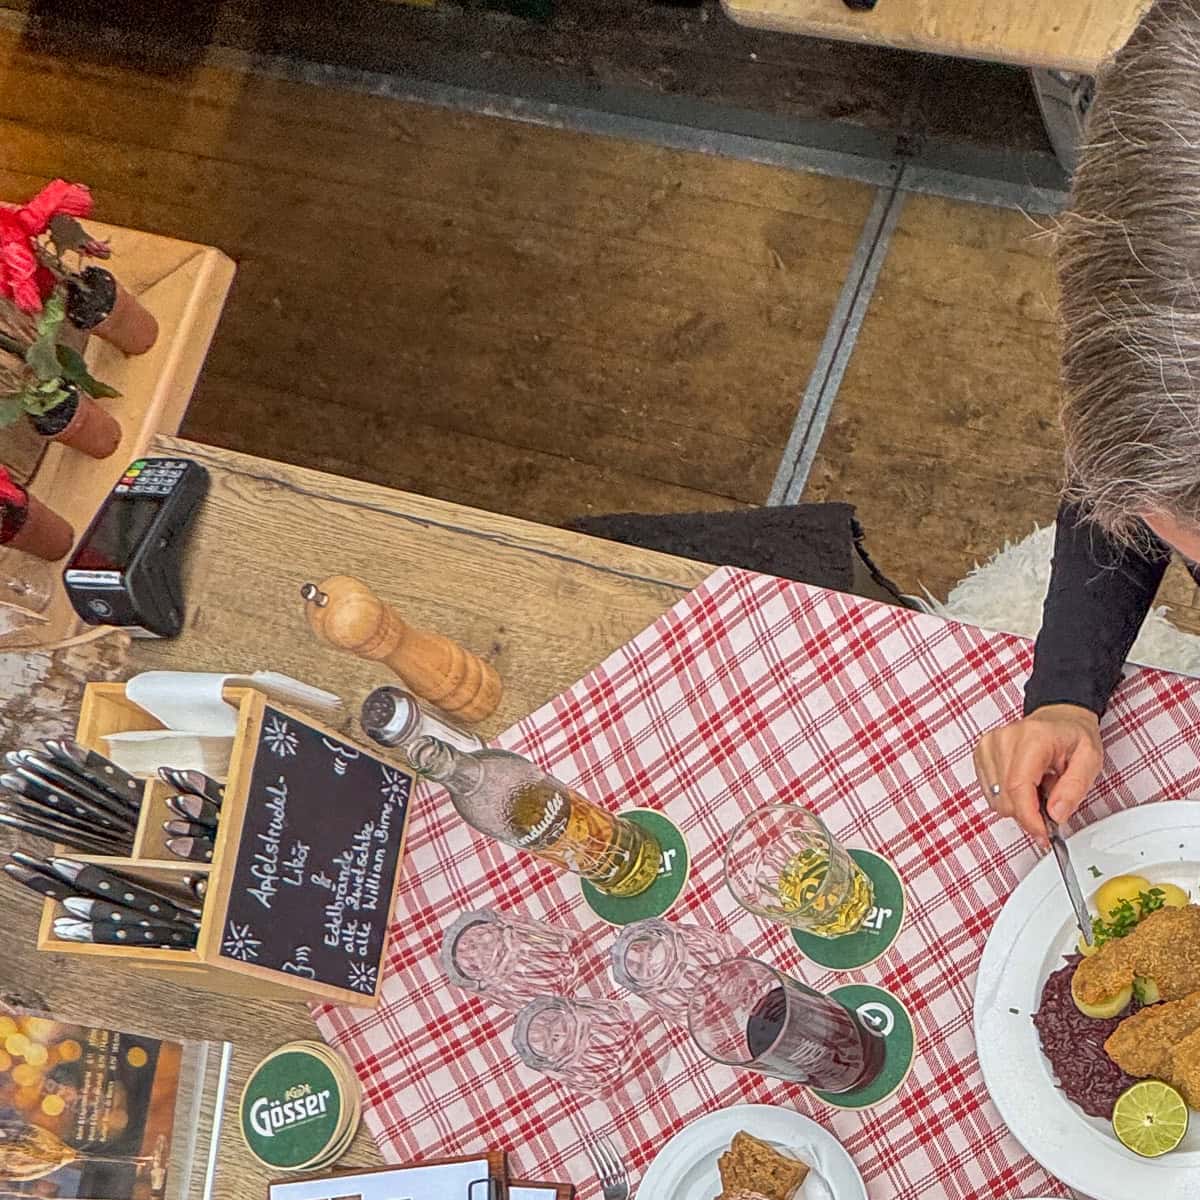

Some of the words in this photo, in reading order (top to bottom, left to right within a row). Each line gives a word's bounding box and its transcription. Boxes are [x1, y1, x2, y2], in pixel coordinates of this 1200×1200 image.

[246, 775, 288, 909] Apfelstrudel-
[375, 801, 395, 843] Birne
[283, 839, 311, 887] Likör
[310, 871, 332, 888] &
[362, 848, 386, 910] William
[324, 850, 354, 947] Edelbrände
[340, 919, 358, 953] alte
[356, 921, 373, 957] alte
[249, 1090, 330, 1137] Gösser
